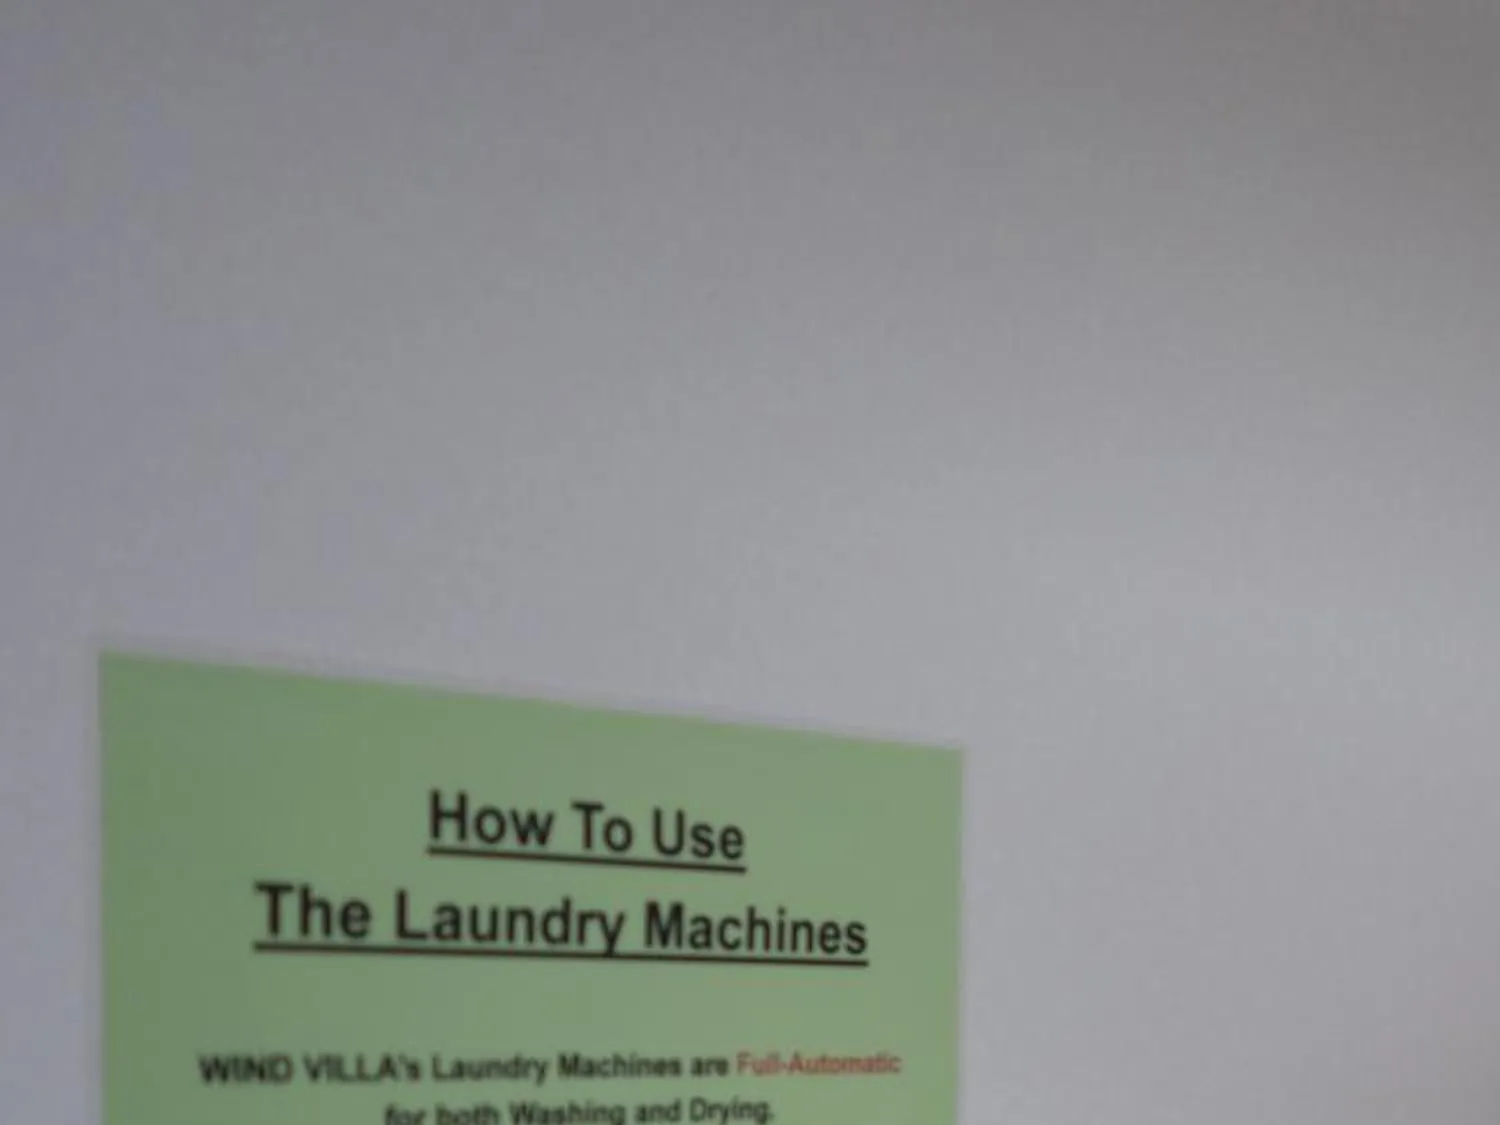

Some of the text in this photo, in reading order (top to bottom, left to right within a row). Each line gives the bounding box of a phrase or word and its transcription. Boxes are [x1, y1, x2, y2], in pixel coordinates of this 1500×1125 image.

[428, 789, 746, 861] How To Use
[254, 880, 868, 957] The Laundry Machines
[198, 1050, 902, 1087] WIND VILLA's Laundry Machines are Full-Automatic
[635, 1099, 682, 1124] and
